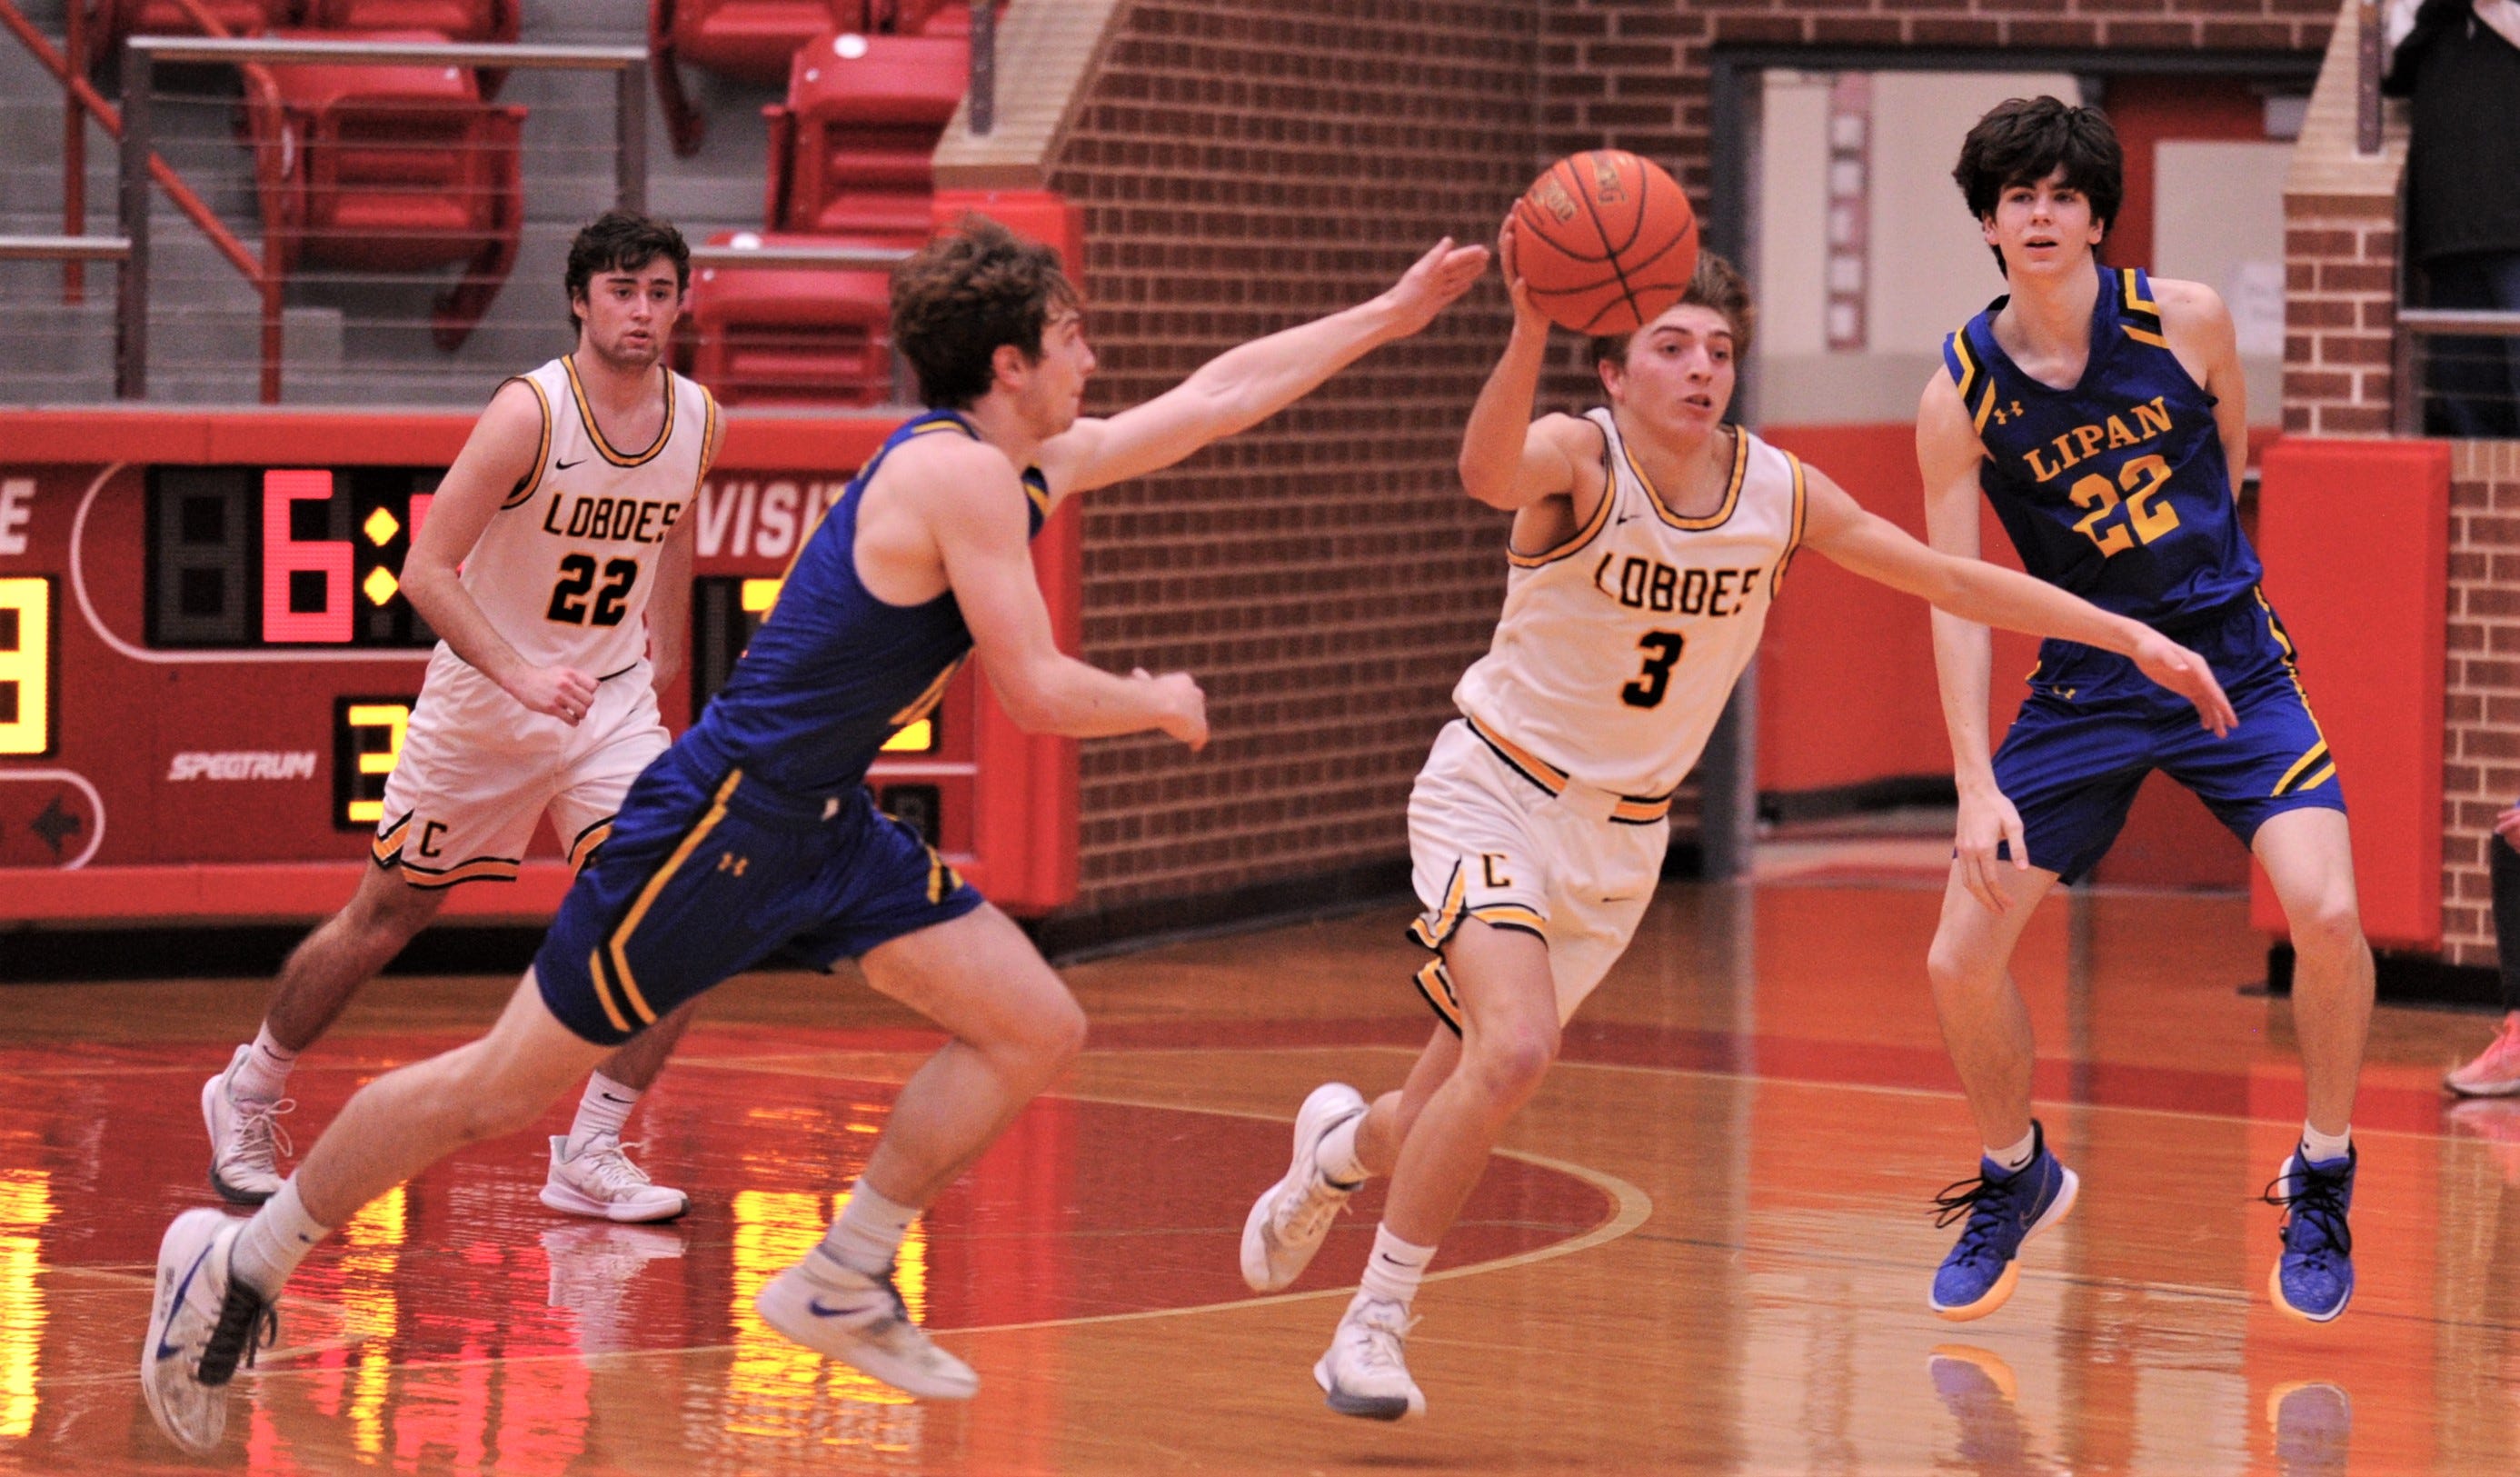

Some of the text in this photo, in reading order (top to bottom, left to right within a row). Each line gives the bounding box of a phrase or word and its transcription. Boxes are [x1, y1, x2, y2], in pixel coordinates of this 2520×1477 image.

[2023, 395, 2174, 483] LIPAN
[543, 493, 681, 544] LOBOES
[2069, 454, 2180, 558] 22
[546, 553, 639, 627] 22
[1595, 552, 1761, 617] LOBOES
[1622, 631, 1684, 708] 3
[168, 754, 316, 781] SPECTRUM
[420, 821, 448, 857] C
[1481, 854, 1511, 888] C
